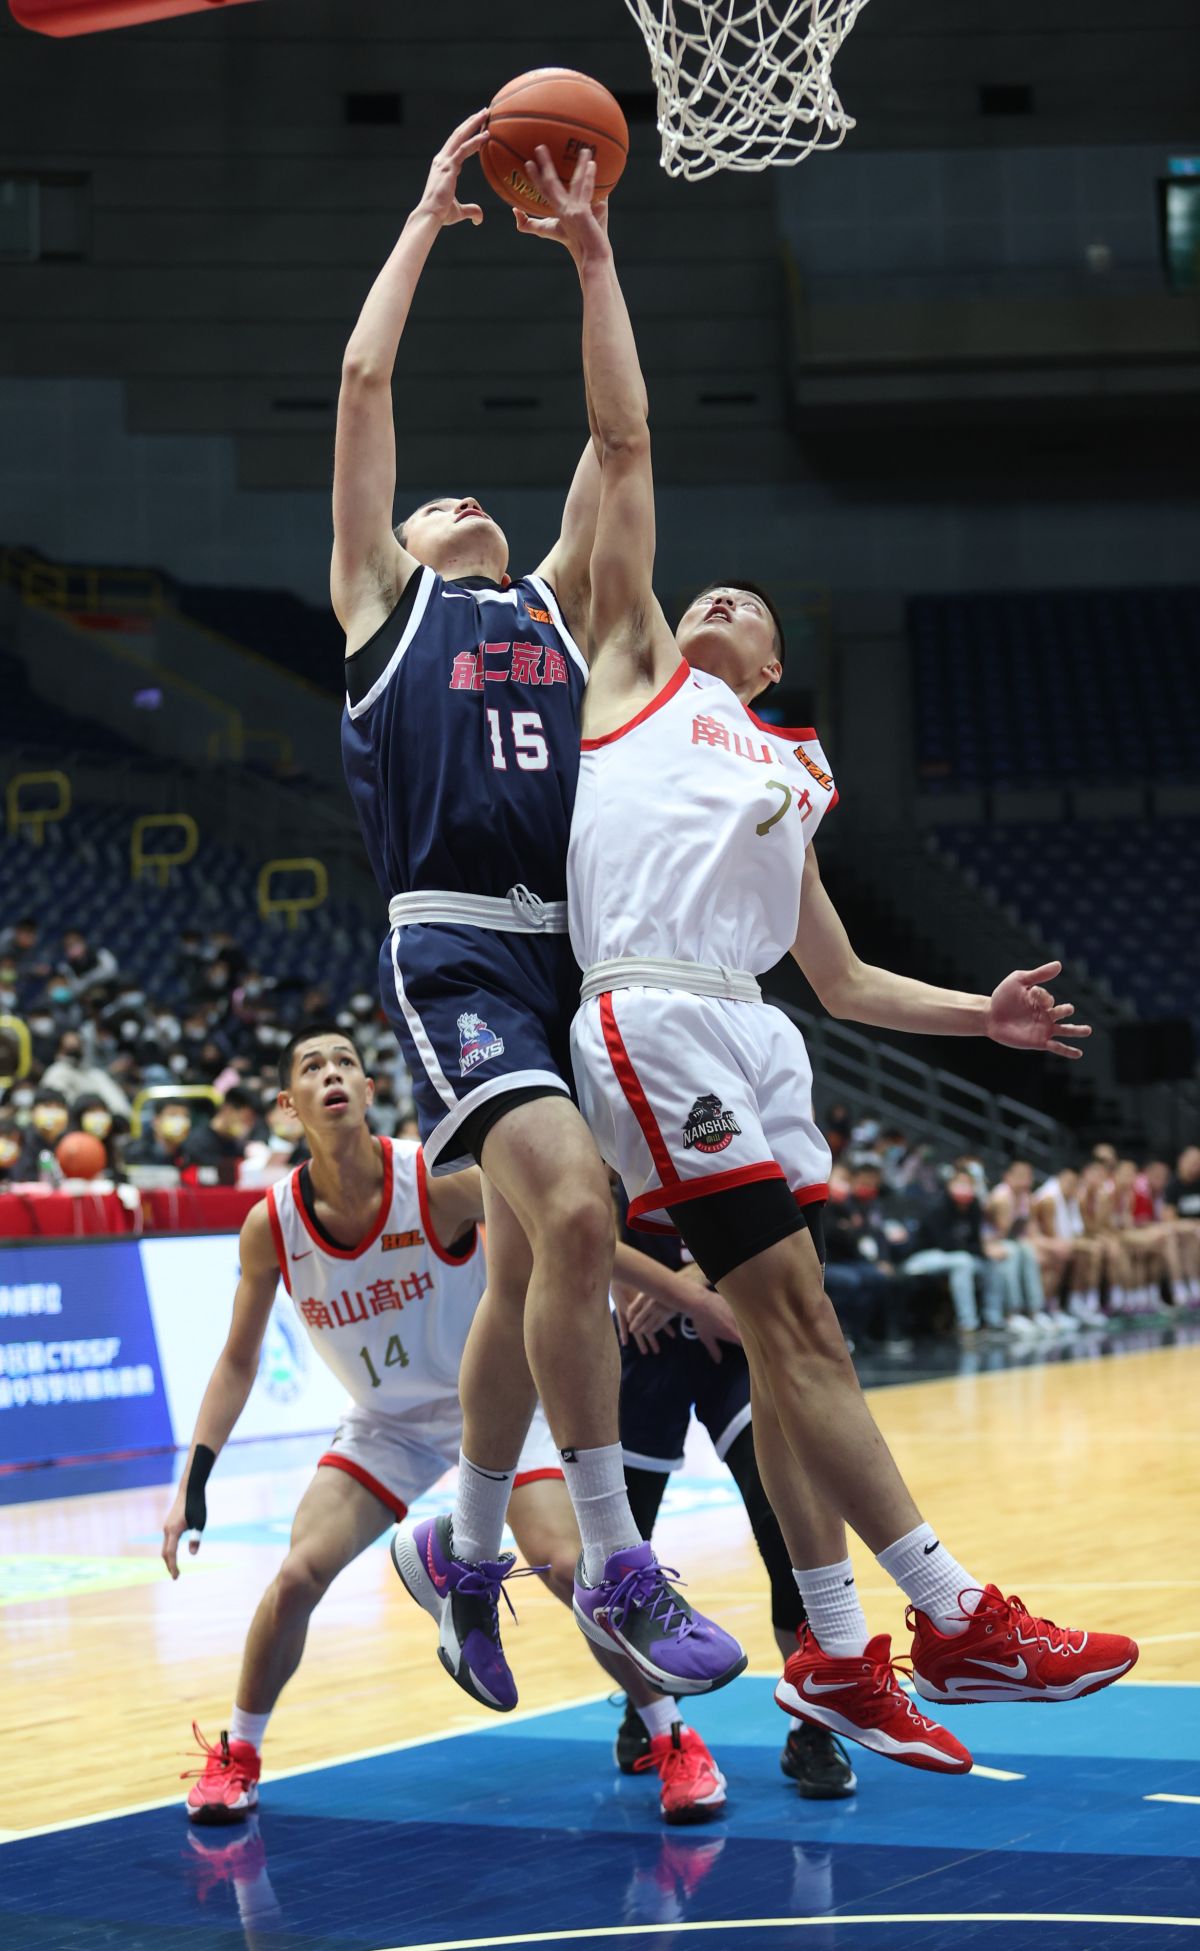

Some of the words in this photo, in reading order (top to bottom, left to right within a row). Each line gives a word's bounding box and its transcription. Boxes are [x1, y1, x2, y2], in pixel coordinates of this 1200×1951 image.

[486, 708, 549, 771] 15
[756, 780, 792, 837] 7
[460, 1041, 503, 1072] NRVS
[683, 1118, 740, 1147] NANSHAN
[382, 1229, 425, 1252] HBL
[301, 1272, 434, 1330] 南山高中
[360, 1334, 409, 1388] 14
